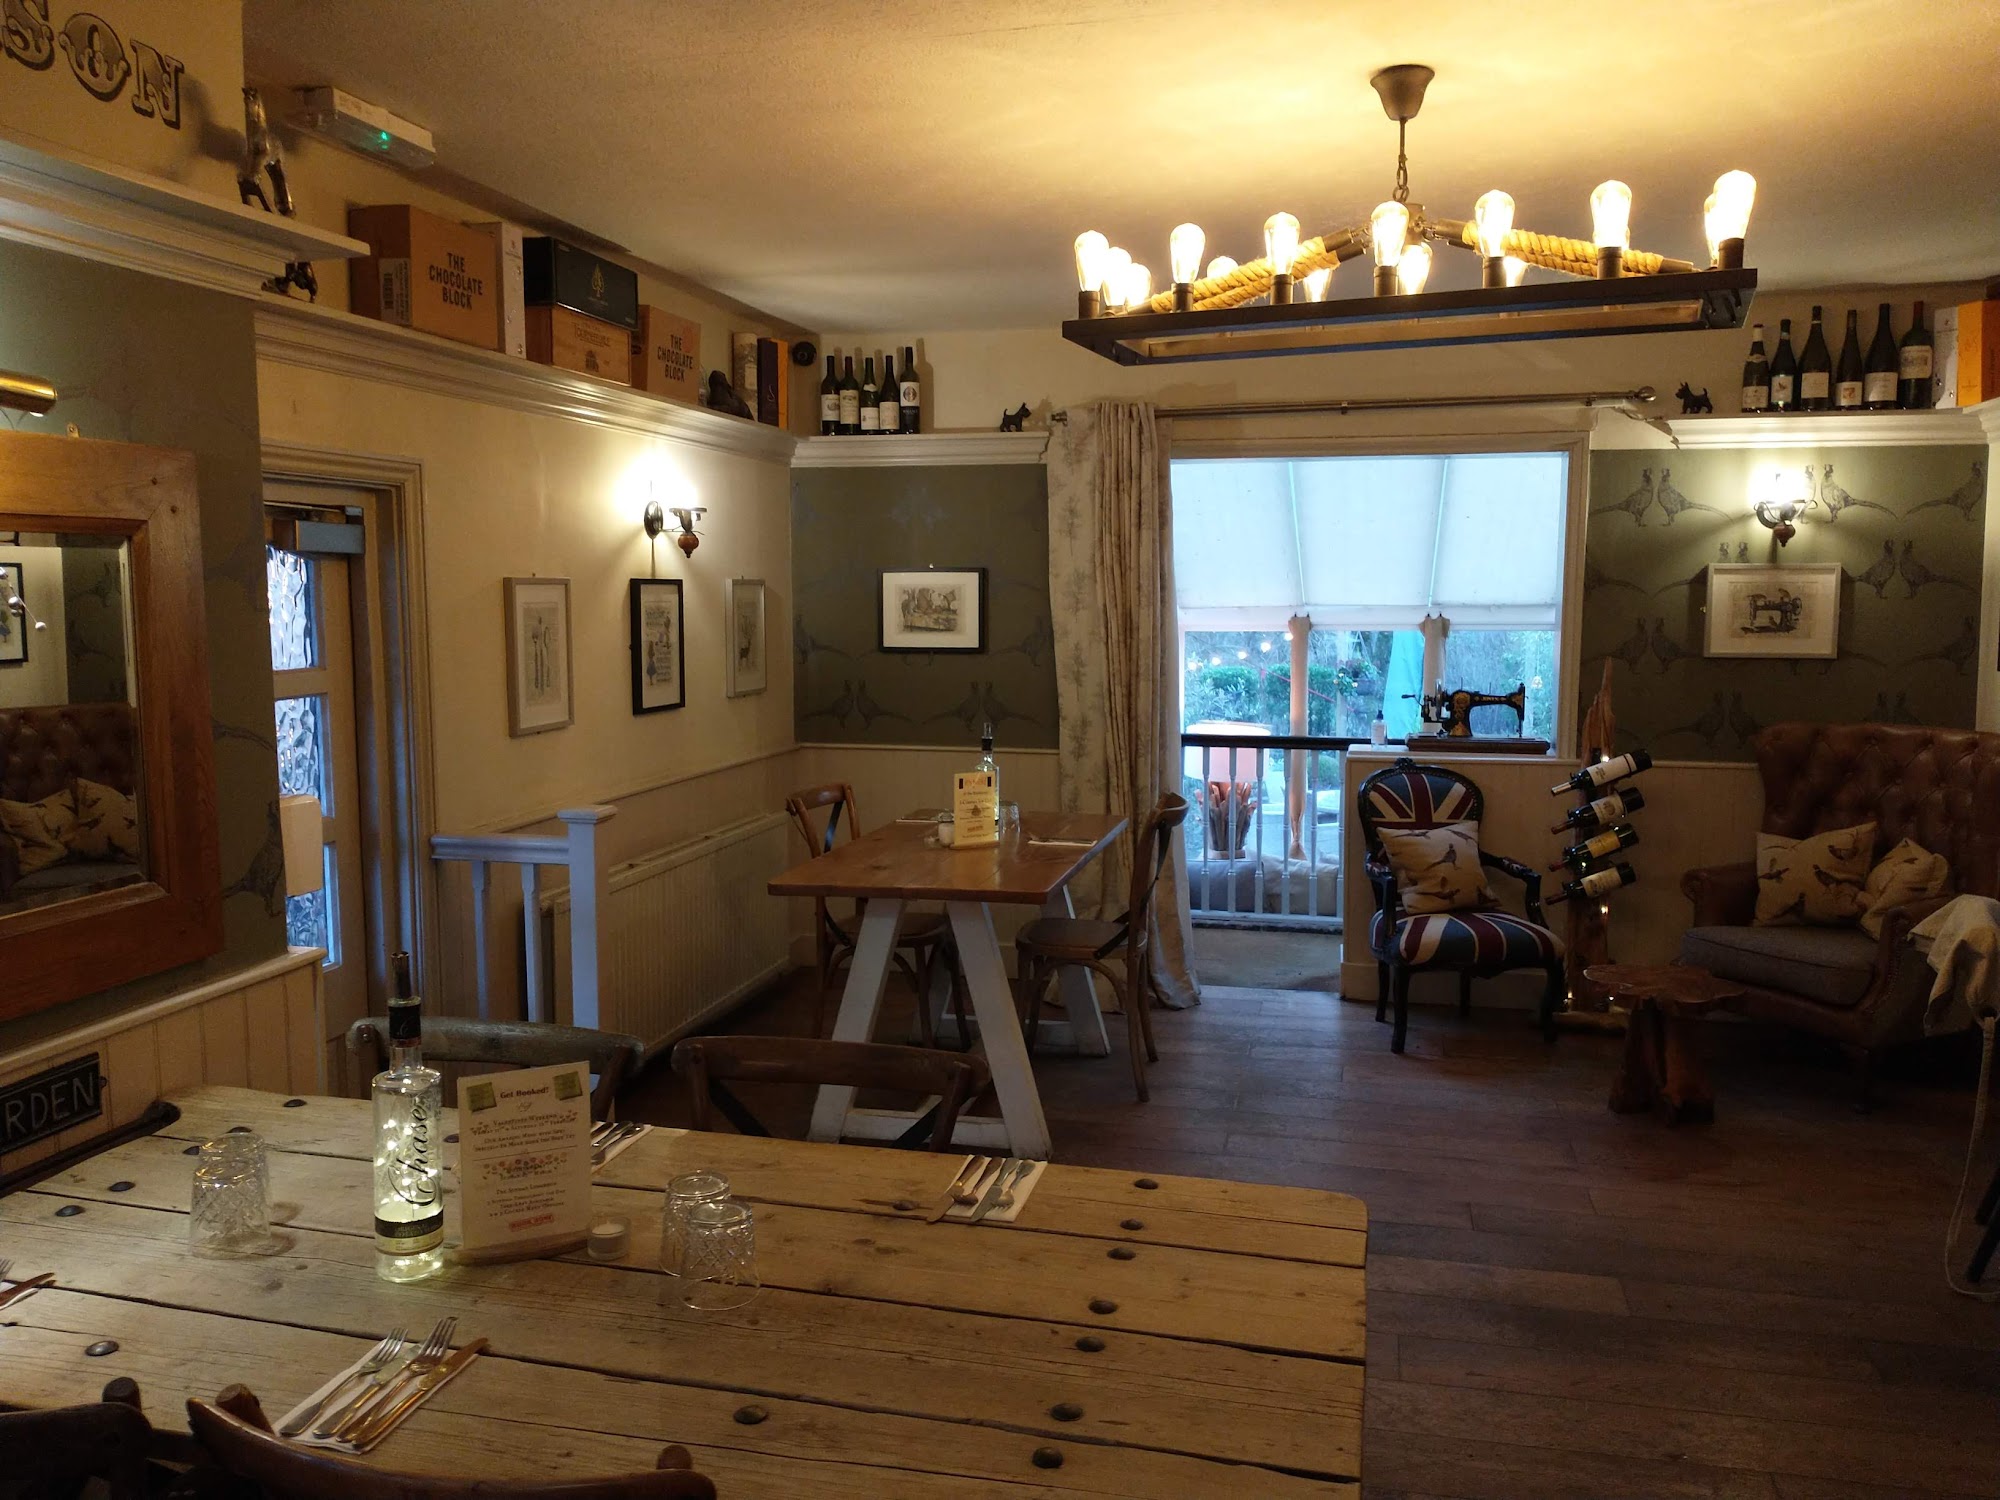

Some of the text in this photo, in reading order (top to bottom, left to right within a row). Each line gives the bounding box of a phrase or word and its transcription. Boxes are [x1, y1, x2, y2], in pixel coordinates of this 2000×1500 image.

[447, 252, 465, 273] THE
[429, 264, 483, 297] CHOCOLATE
[442, 287, 472, 311] BLOCK
[670, 334, 683, 350] THE
[657, 345, 694, 370] CHOCOLATE
[664, 364, 685, 384] BLOCK
[5, 1071, 95, 1140] RDEN
[500, 1091, 515, 1100] Get
[387, 1099, 435, 1210] Chase
